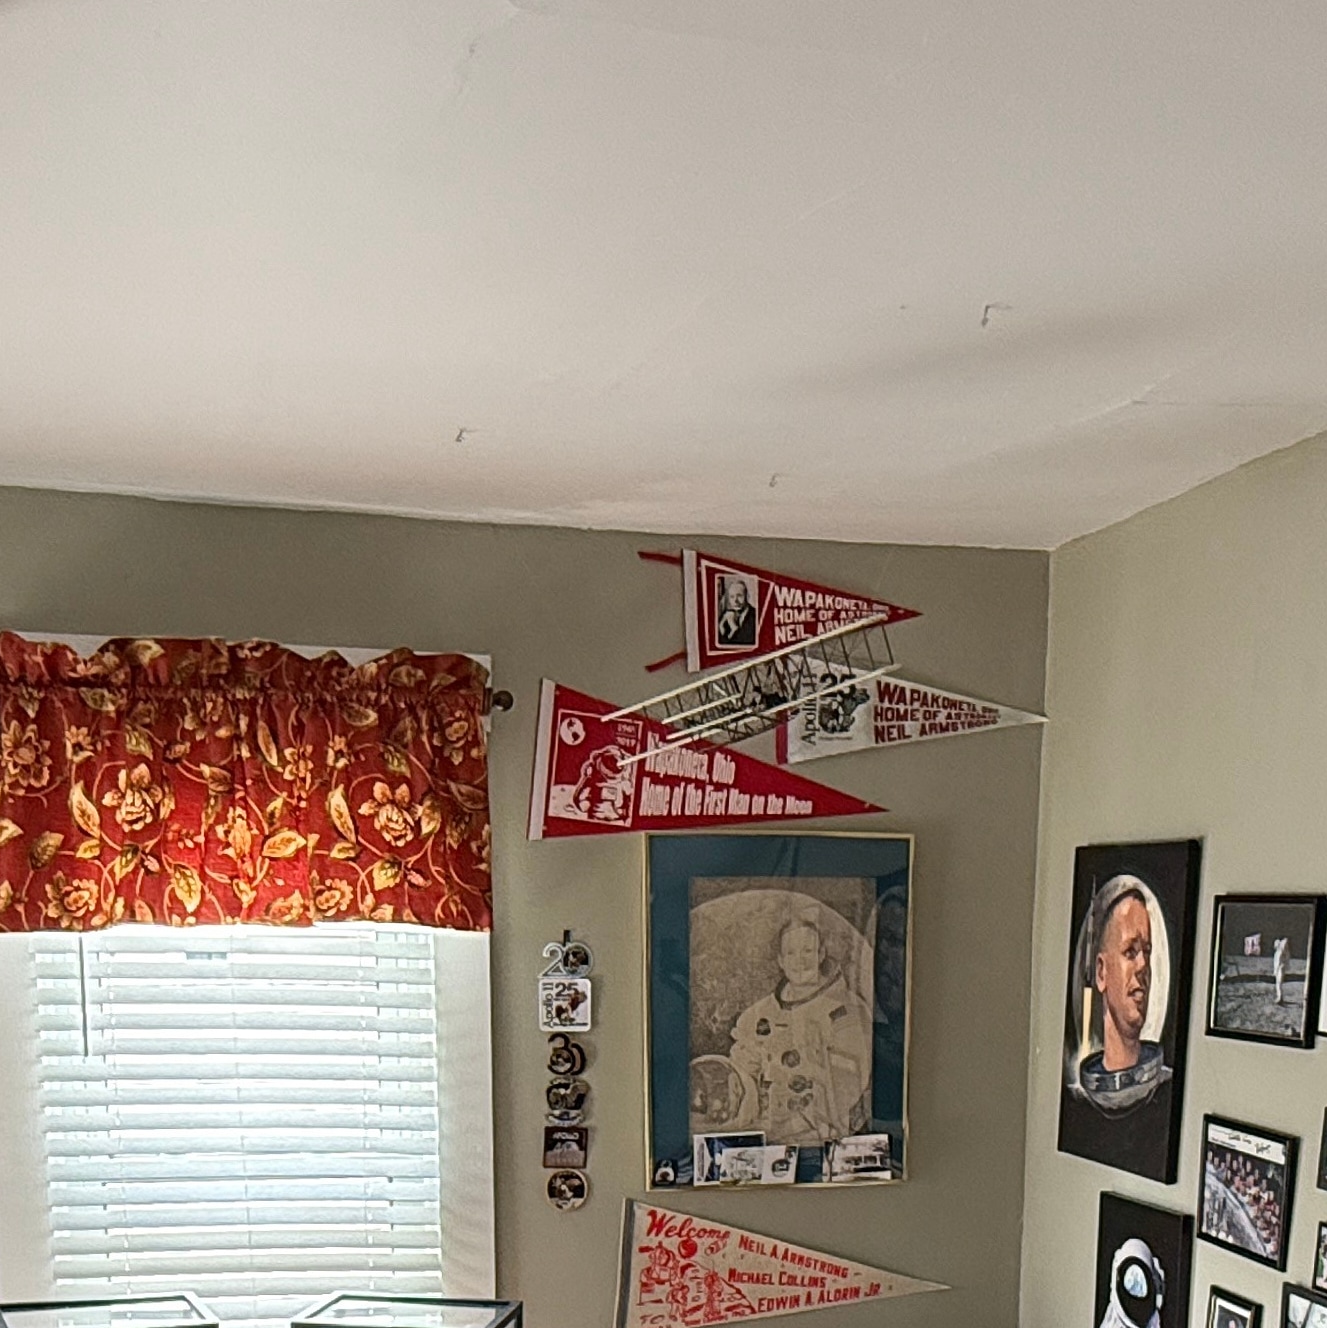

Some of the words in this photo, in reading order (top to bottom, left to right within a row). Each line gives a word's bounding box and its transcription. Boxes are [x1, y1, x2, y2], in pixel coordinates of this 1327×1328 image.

[774, 608, 815, 624] HOME
[818, 609, 836, 621] OF
[774, 624, 813, 645] NEIL
[874, 706, 921, 722] HOME
[923, 709, 944, 721] OF
[875, 723, 912, 744] NEIL
[919, 718, 999, 738] ARMSTRONG
[712, 751, 736, 785] Ohio
[639, 776, 671, 816] Home
[672, 781, 685, 816] of
[685, 783, 703, 816] the
[703, 784, 727, 816] First
[727, 788, 750, 815] Man
[752, 795, 765, 815] on
[767, 793, 783, 815] the
[785, 795, 813, 815] Moon
[543, 993, 554, 1029] Apollo
[646, 1209, 731, 1240] Welcome
[738, 1234, 766, 1255] NEIL
[781, 1247, 849, 1279] ARMSTRONG
[728, 1267, 775, 1286] MICHAEL
[778, 1271, 828, 1288] COLLINS
[757, 1296, 800, 1313] EDWIN
[818, 1284, 861, 1305] ALDRIN
